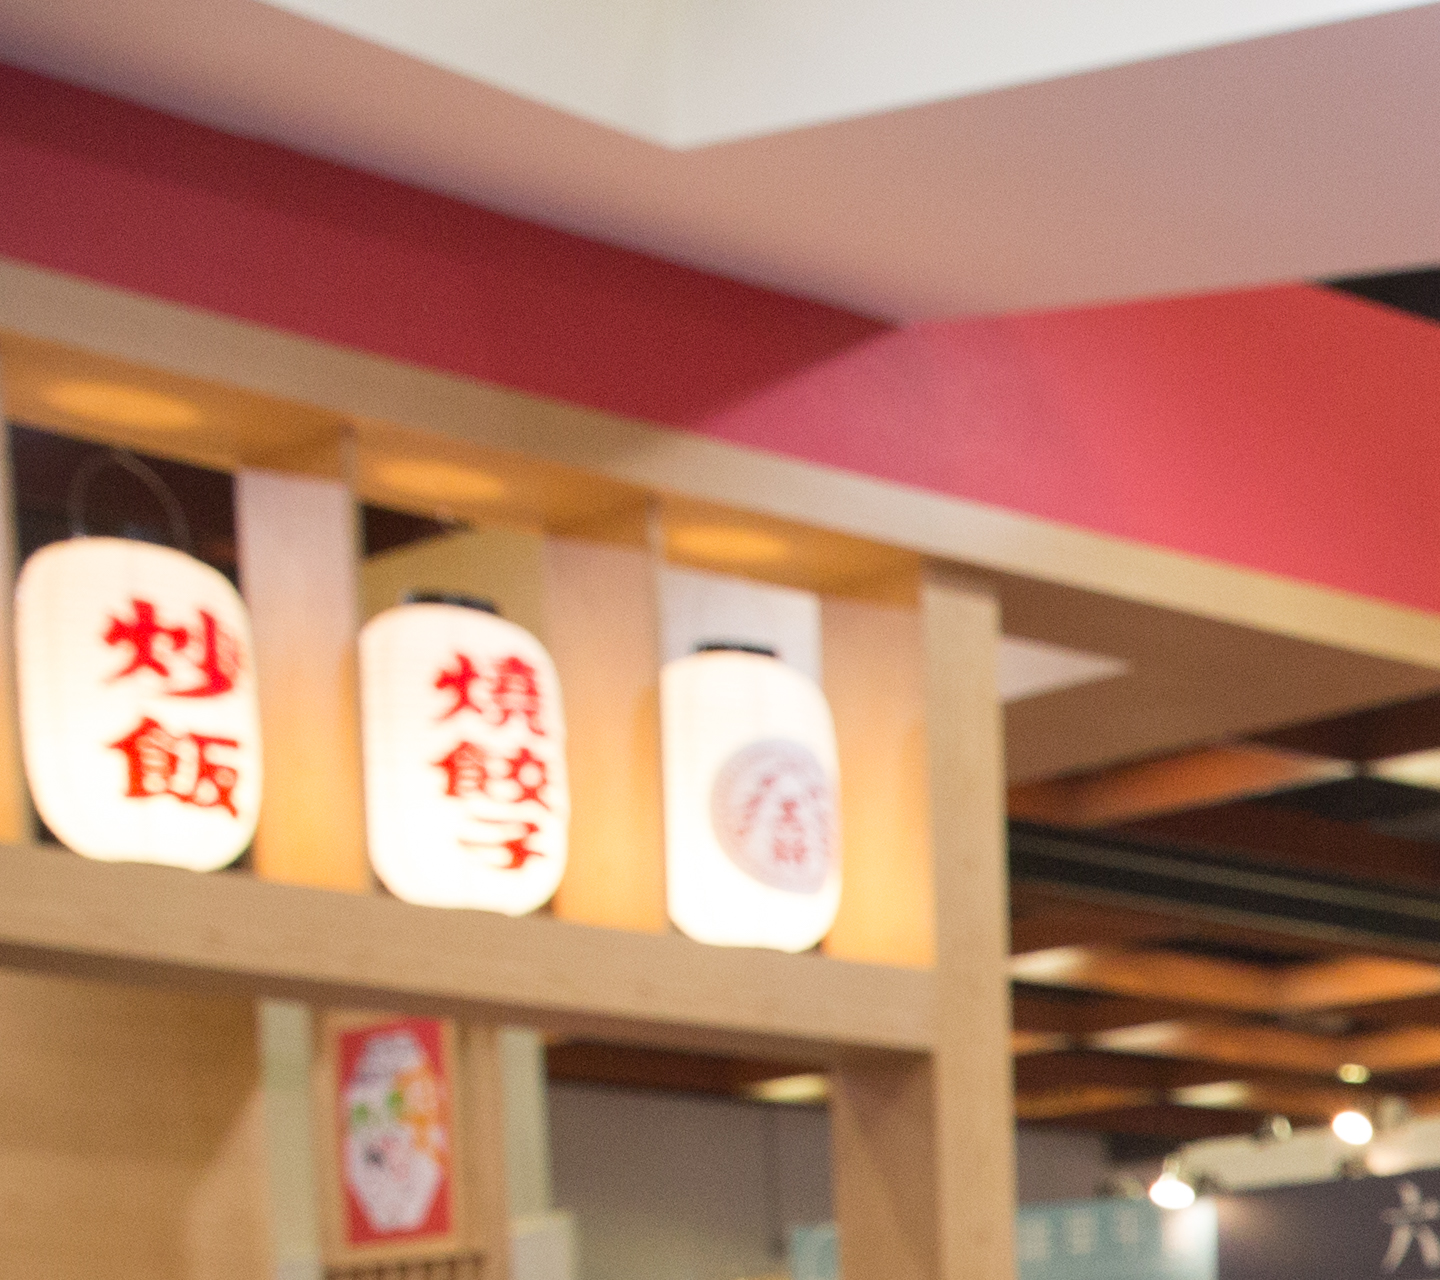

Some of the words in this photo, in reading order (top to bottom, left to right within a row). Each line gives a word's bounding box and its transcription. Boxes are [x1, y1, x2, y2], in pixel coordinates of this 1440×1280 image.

[103, 599, 241, 820] 炒飯
[433, 651, 551, 871] 燒餃子
